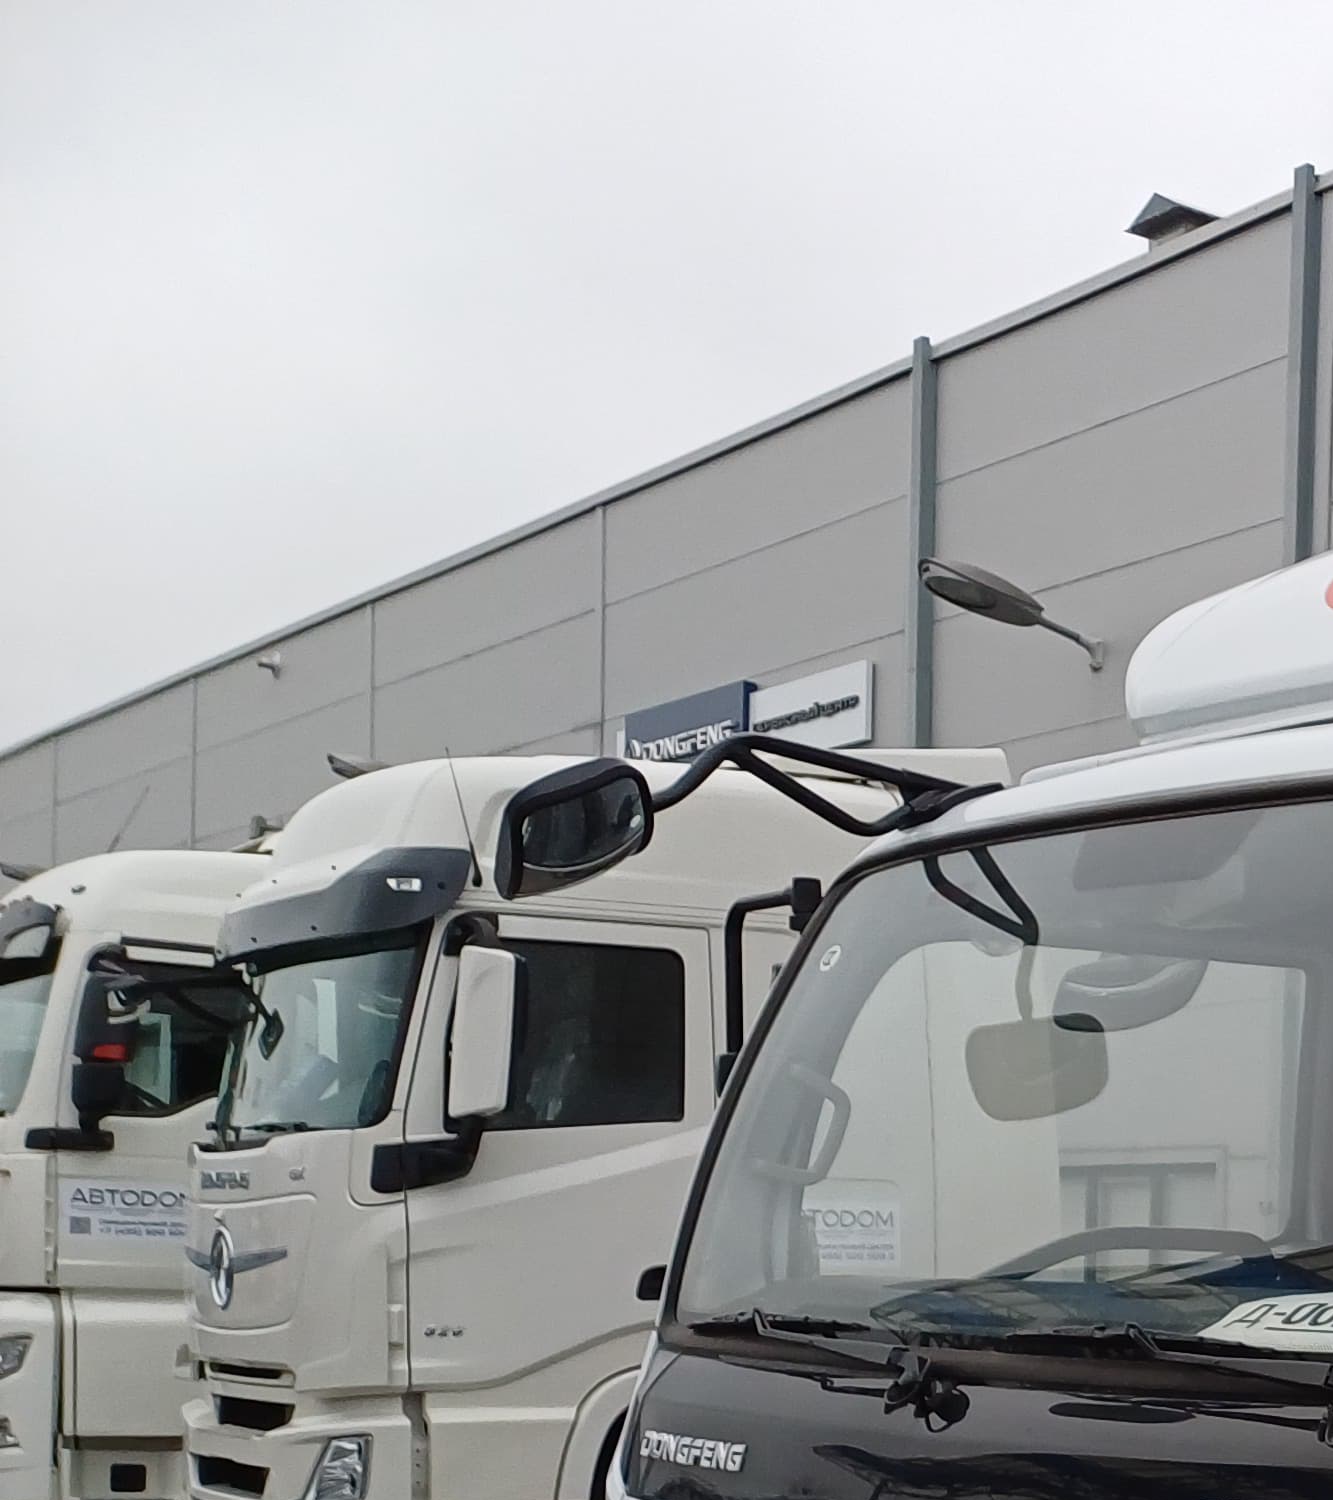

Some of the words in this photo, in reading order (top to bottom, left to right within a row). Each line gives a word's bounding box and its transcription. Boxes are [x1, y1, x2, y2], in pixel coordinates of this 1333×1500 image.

[641, 719, 737, 761] DONGFENG
[802, 1208, 894, 1228] TODOM
[640, 1430, 747, 1472] DONGFENG
